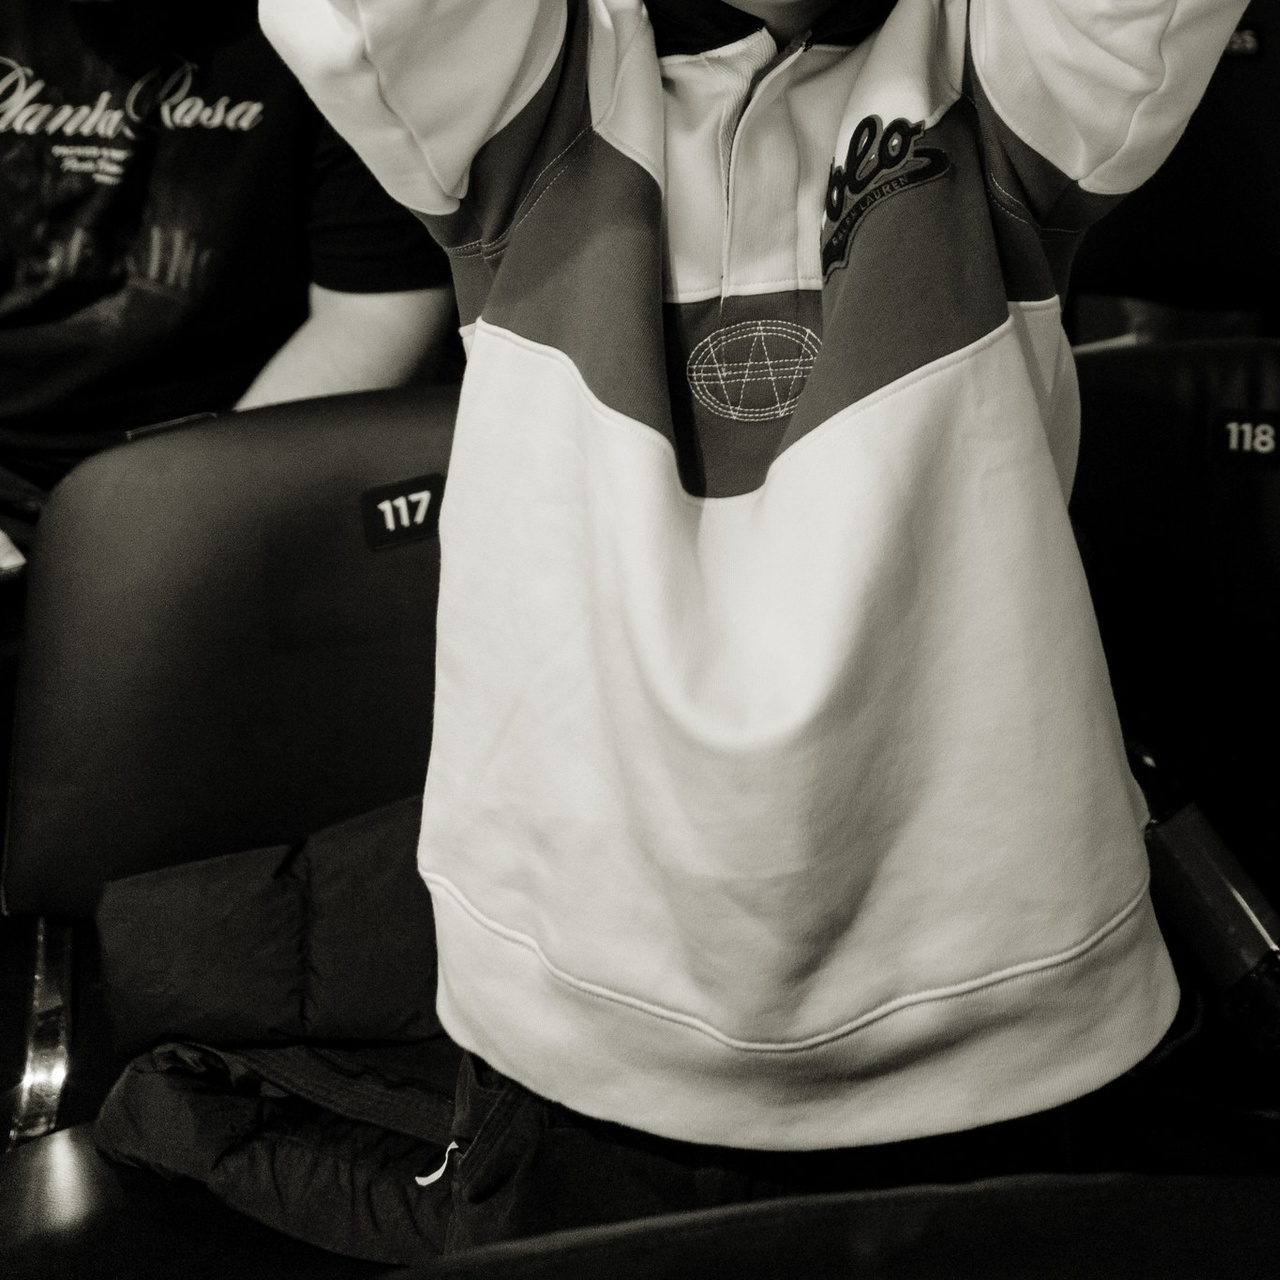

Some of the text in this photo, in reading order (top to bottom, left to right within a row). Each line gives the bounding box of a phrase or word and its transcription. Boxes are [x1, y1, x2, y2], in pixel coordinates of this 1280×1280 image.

[826, 114, 925, 222] olo
[860, 174, 909, 210] LAUREN
[1226, 422, 1276, 453] 118
[377, 490, 431, 532] 117
